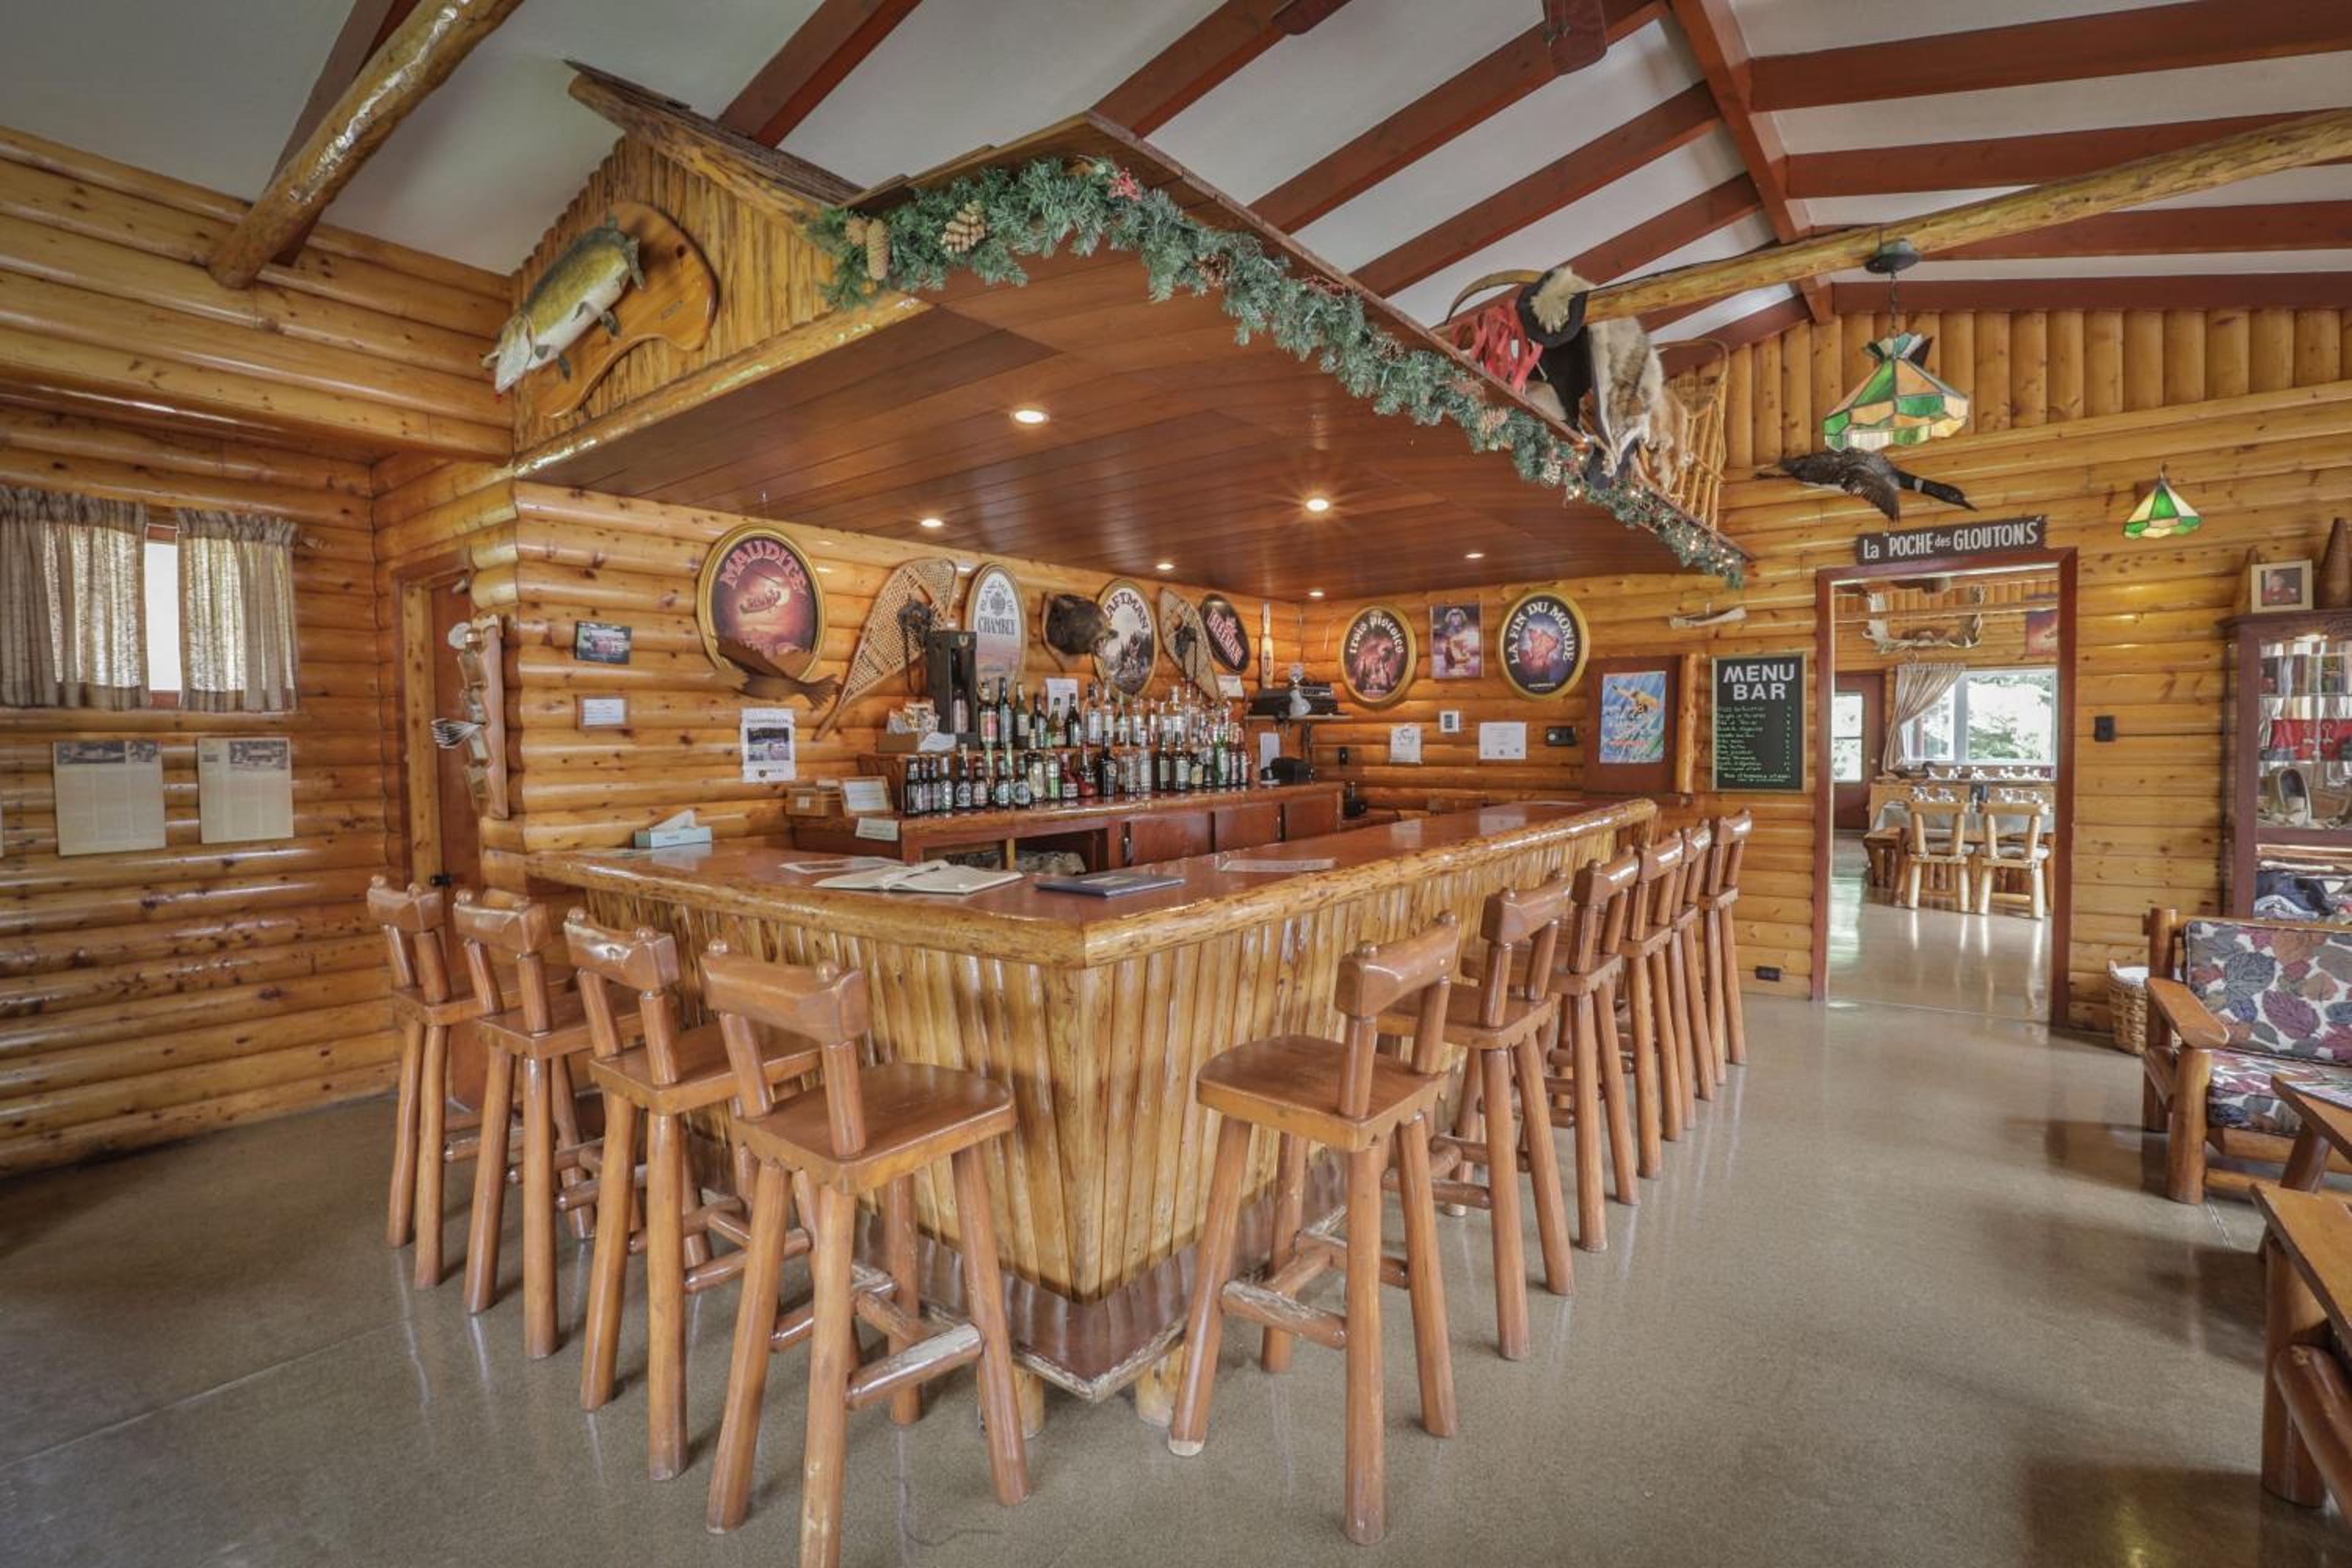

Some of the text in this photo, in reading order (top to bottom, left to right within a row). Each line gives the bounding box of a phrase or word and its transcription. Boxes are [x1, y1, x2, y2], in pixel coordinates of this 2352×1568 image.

[1863, 539, 1879, 559] La
[1934, 535, 1951, 548] des
[719, 539, 808, 597] MAUDITE
[1105, 591, 1149, 629] AFTMAN
[1507, 601, 1575, 665] LA FIN DU MONDE
[1722, 663, 1795, 684] MENU
[1733, 682, 1787, 701] BAR
